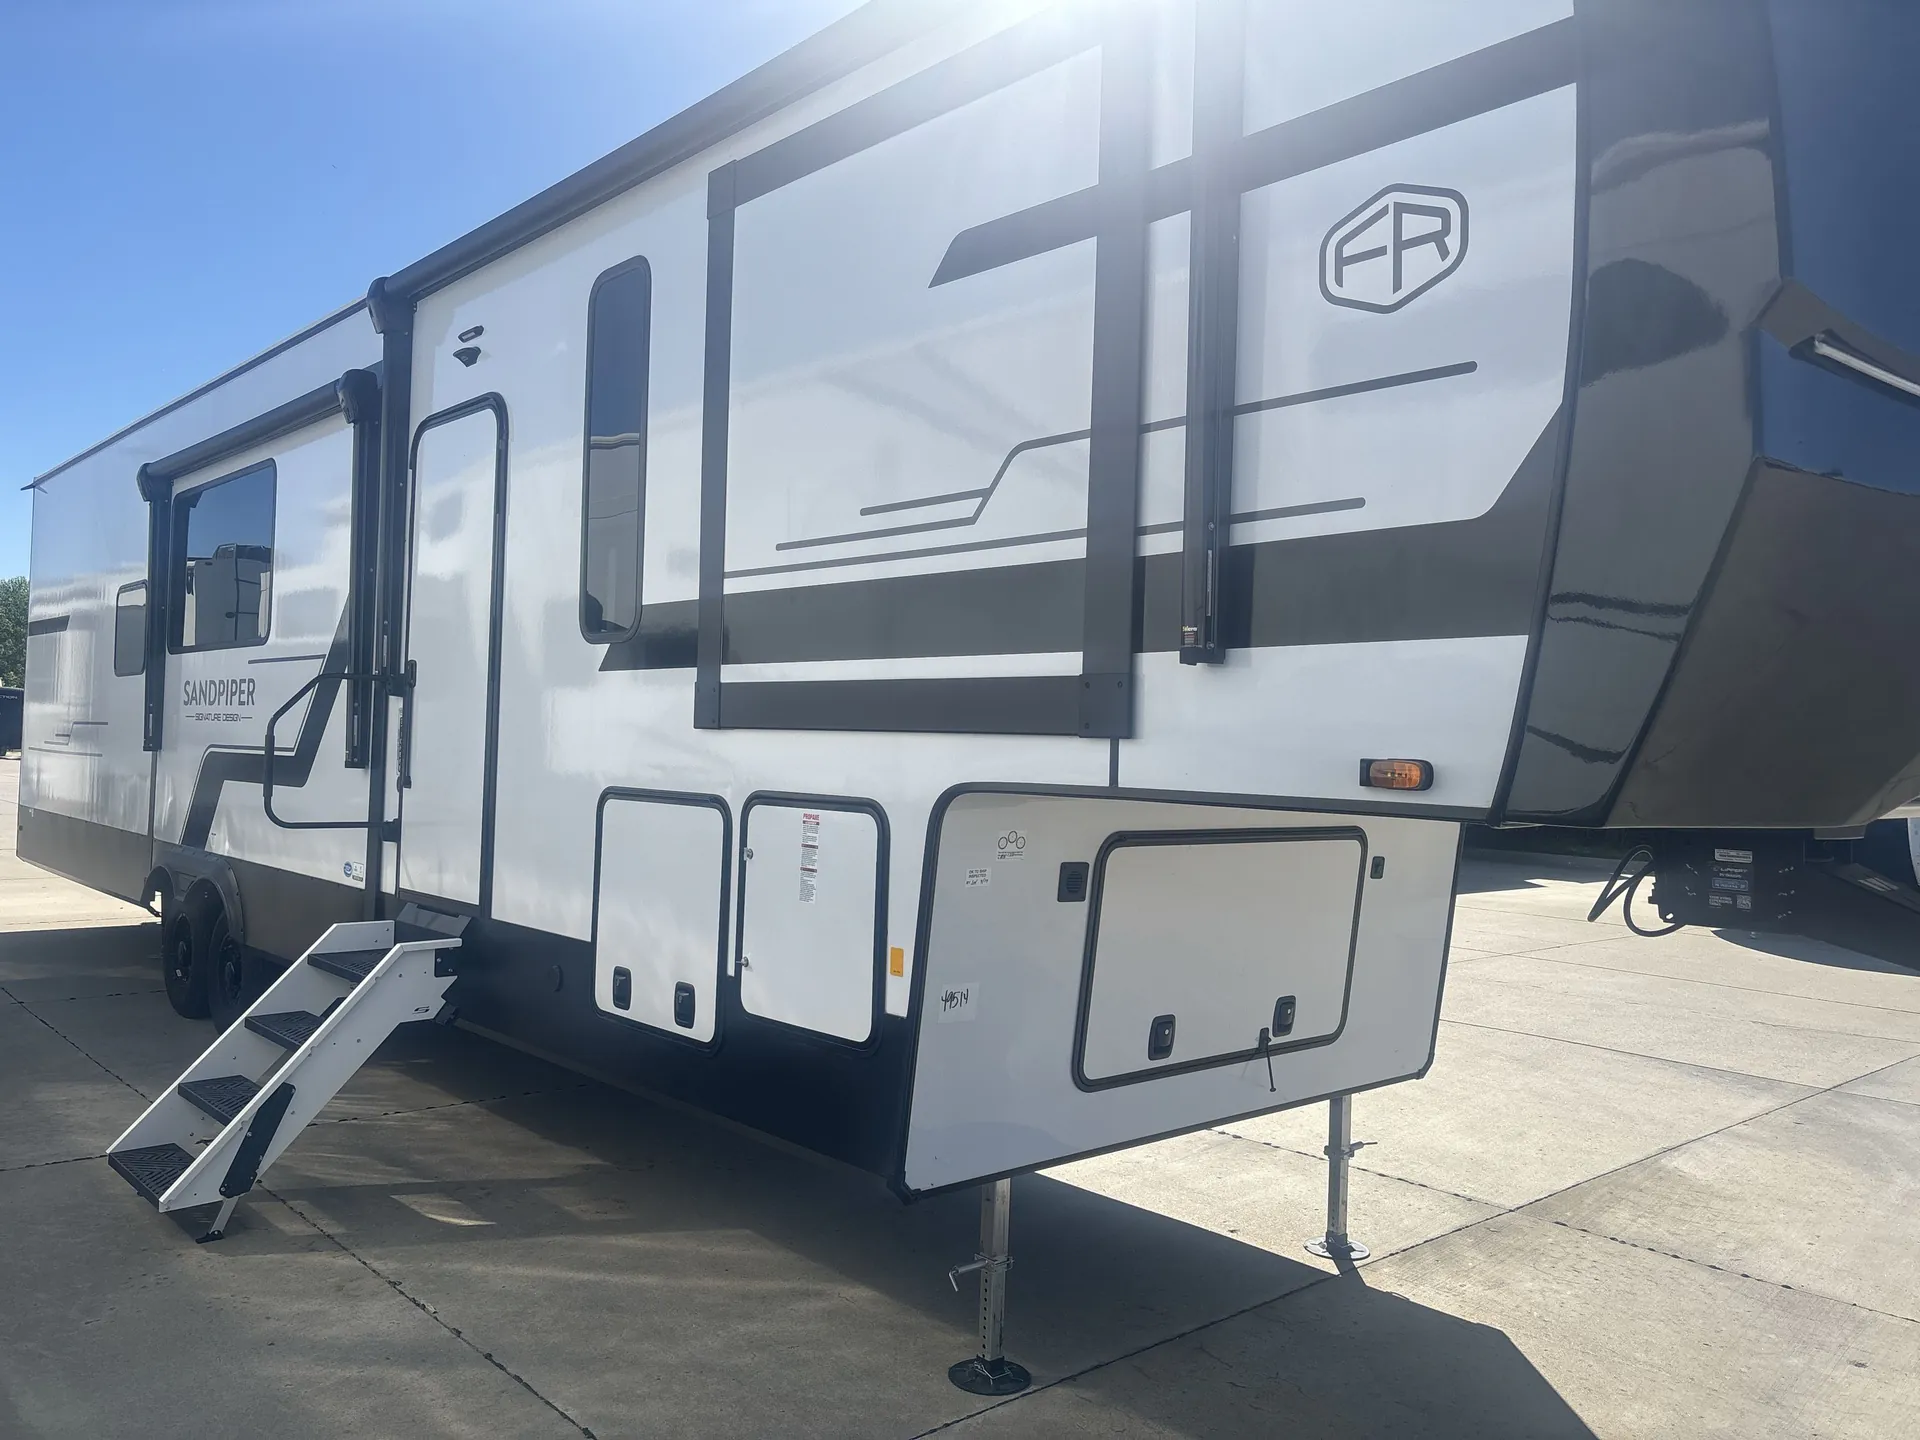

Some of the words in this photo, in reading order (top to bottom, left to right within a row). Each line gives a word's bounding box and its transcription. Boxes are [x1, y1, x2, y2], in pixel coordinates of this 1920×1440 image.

[1335, 201, 1451, 295] FR
[183, 678, 256, 706] SANDPIPER
[195, 713, 221, 721] SIGNATURE
[222, 713, 241, 721] DESIGN
